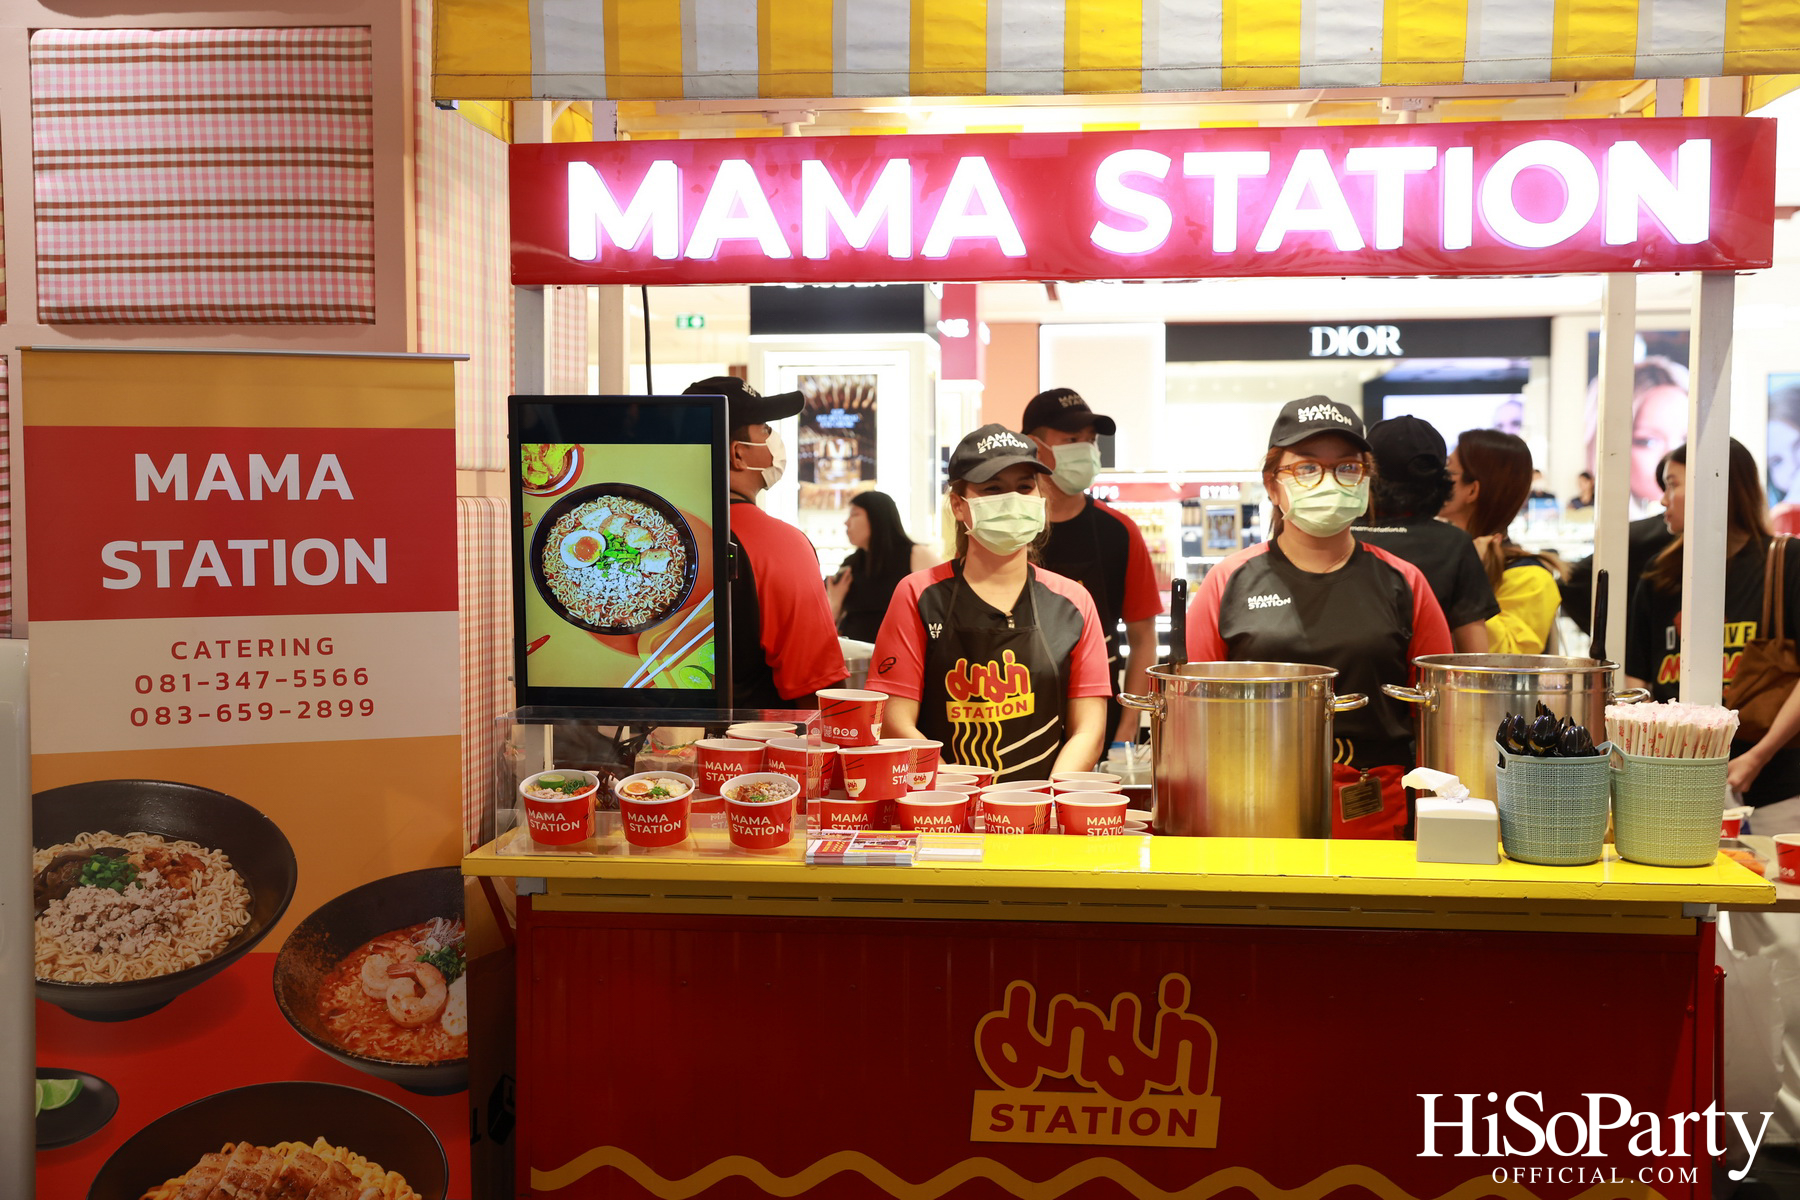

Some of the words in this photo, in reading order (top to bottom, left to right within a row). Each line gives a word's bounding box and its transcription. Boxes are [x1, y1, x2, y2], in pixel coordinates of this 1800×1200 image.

[568, 156, 1027, 260] MAMA
[1090, 138, 1712, 255] STATION
[1309, 325, 1404, 357] DIOR
[1297, 403, 1340, 416] MAMA
[1298, 411, 1353, 427] STATION
[977, 431, 1016, 450] MAMA
[978, 438, 1029, 454] STATION
[135, 453, 355, 502] MAMA
[101, 538, 388, 590] STATION
[1247, 593, 1281, 604] MAMA
[1248, 597, 1292, 610] STATION
[171, 637, 335, 661] CATERING
[135, 667, 370, 695] 081-347-5566
[130, 698, 374, 727] 083-659-2899
[951, 699, 1028, 719] STATION
[705, 760, 744, 772] MAMA
[528, 807, 566, 822] MAMA
[627, 811, 669, 824] MAMA
[731, 812, 771, 825] MAMA
[831, 813, 869, 823] MAMA
[913, 815, 953, 825] MAMA
[1086, 815, 1123, 826] MAMA
[530, 820, 581, 832] STATION
[629, 820, 682, 834] STATION
[733, 823, 784, 836] STATION
[989, 1103, 1198, 1138] STATION
